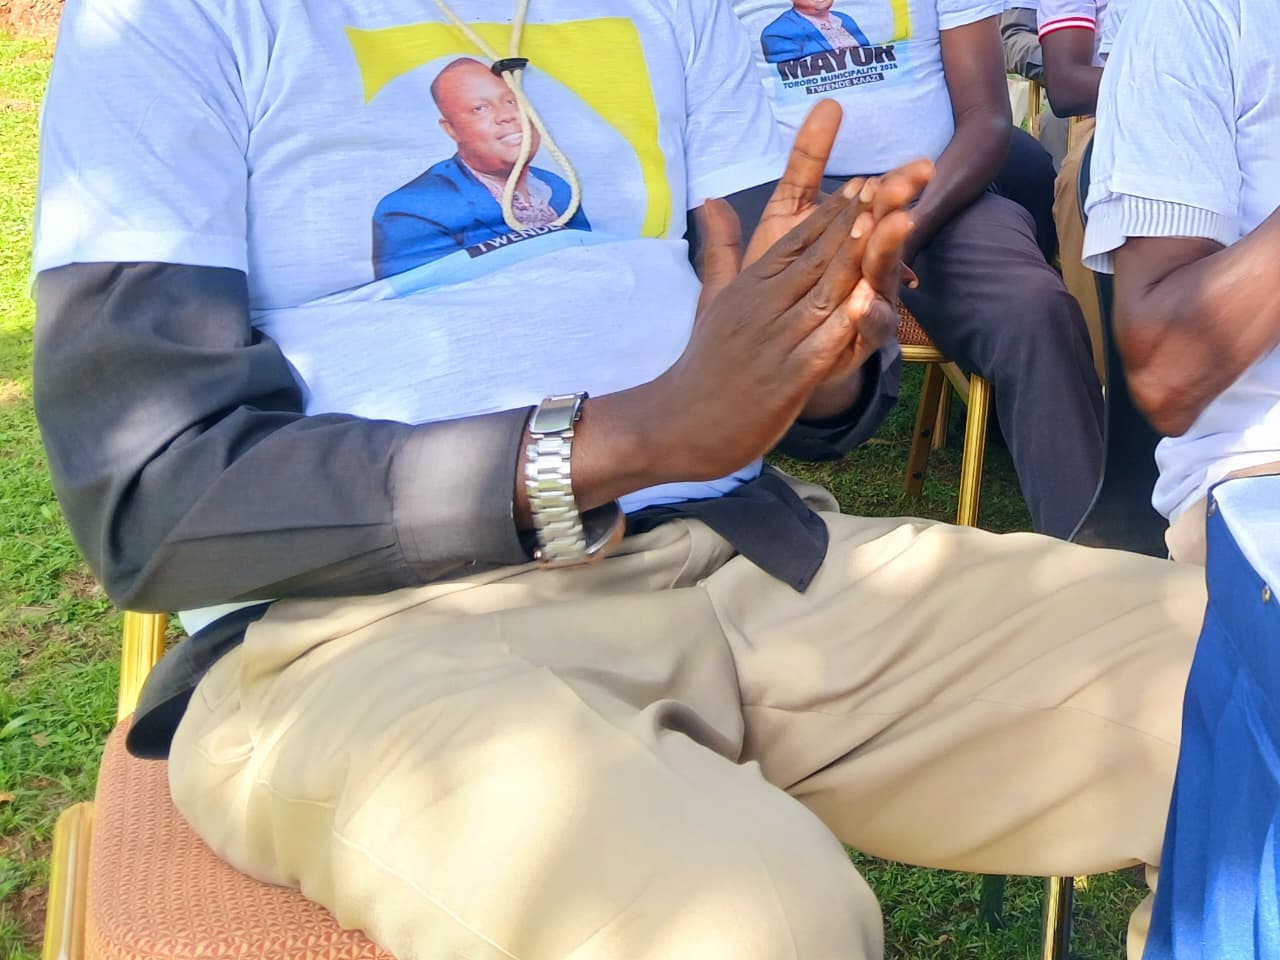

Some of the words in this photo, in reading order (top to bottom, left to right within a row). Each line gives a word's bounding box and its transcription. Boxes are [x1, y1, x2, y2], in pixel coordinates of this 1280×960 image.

[777, 45, 897, 81] MAYOR
[783, 77, 818, 89] TORORO
[820, 66, 878, 83] MUNICIPALITY
[852, 74, 880, 85] KAAZI
